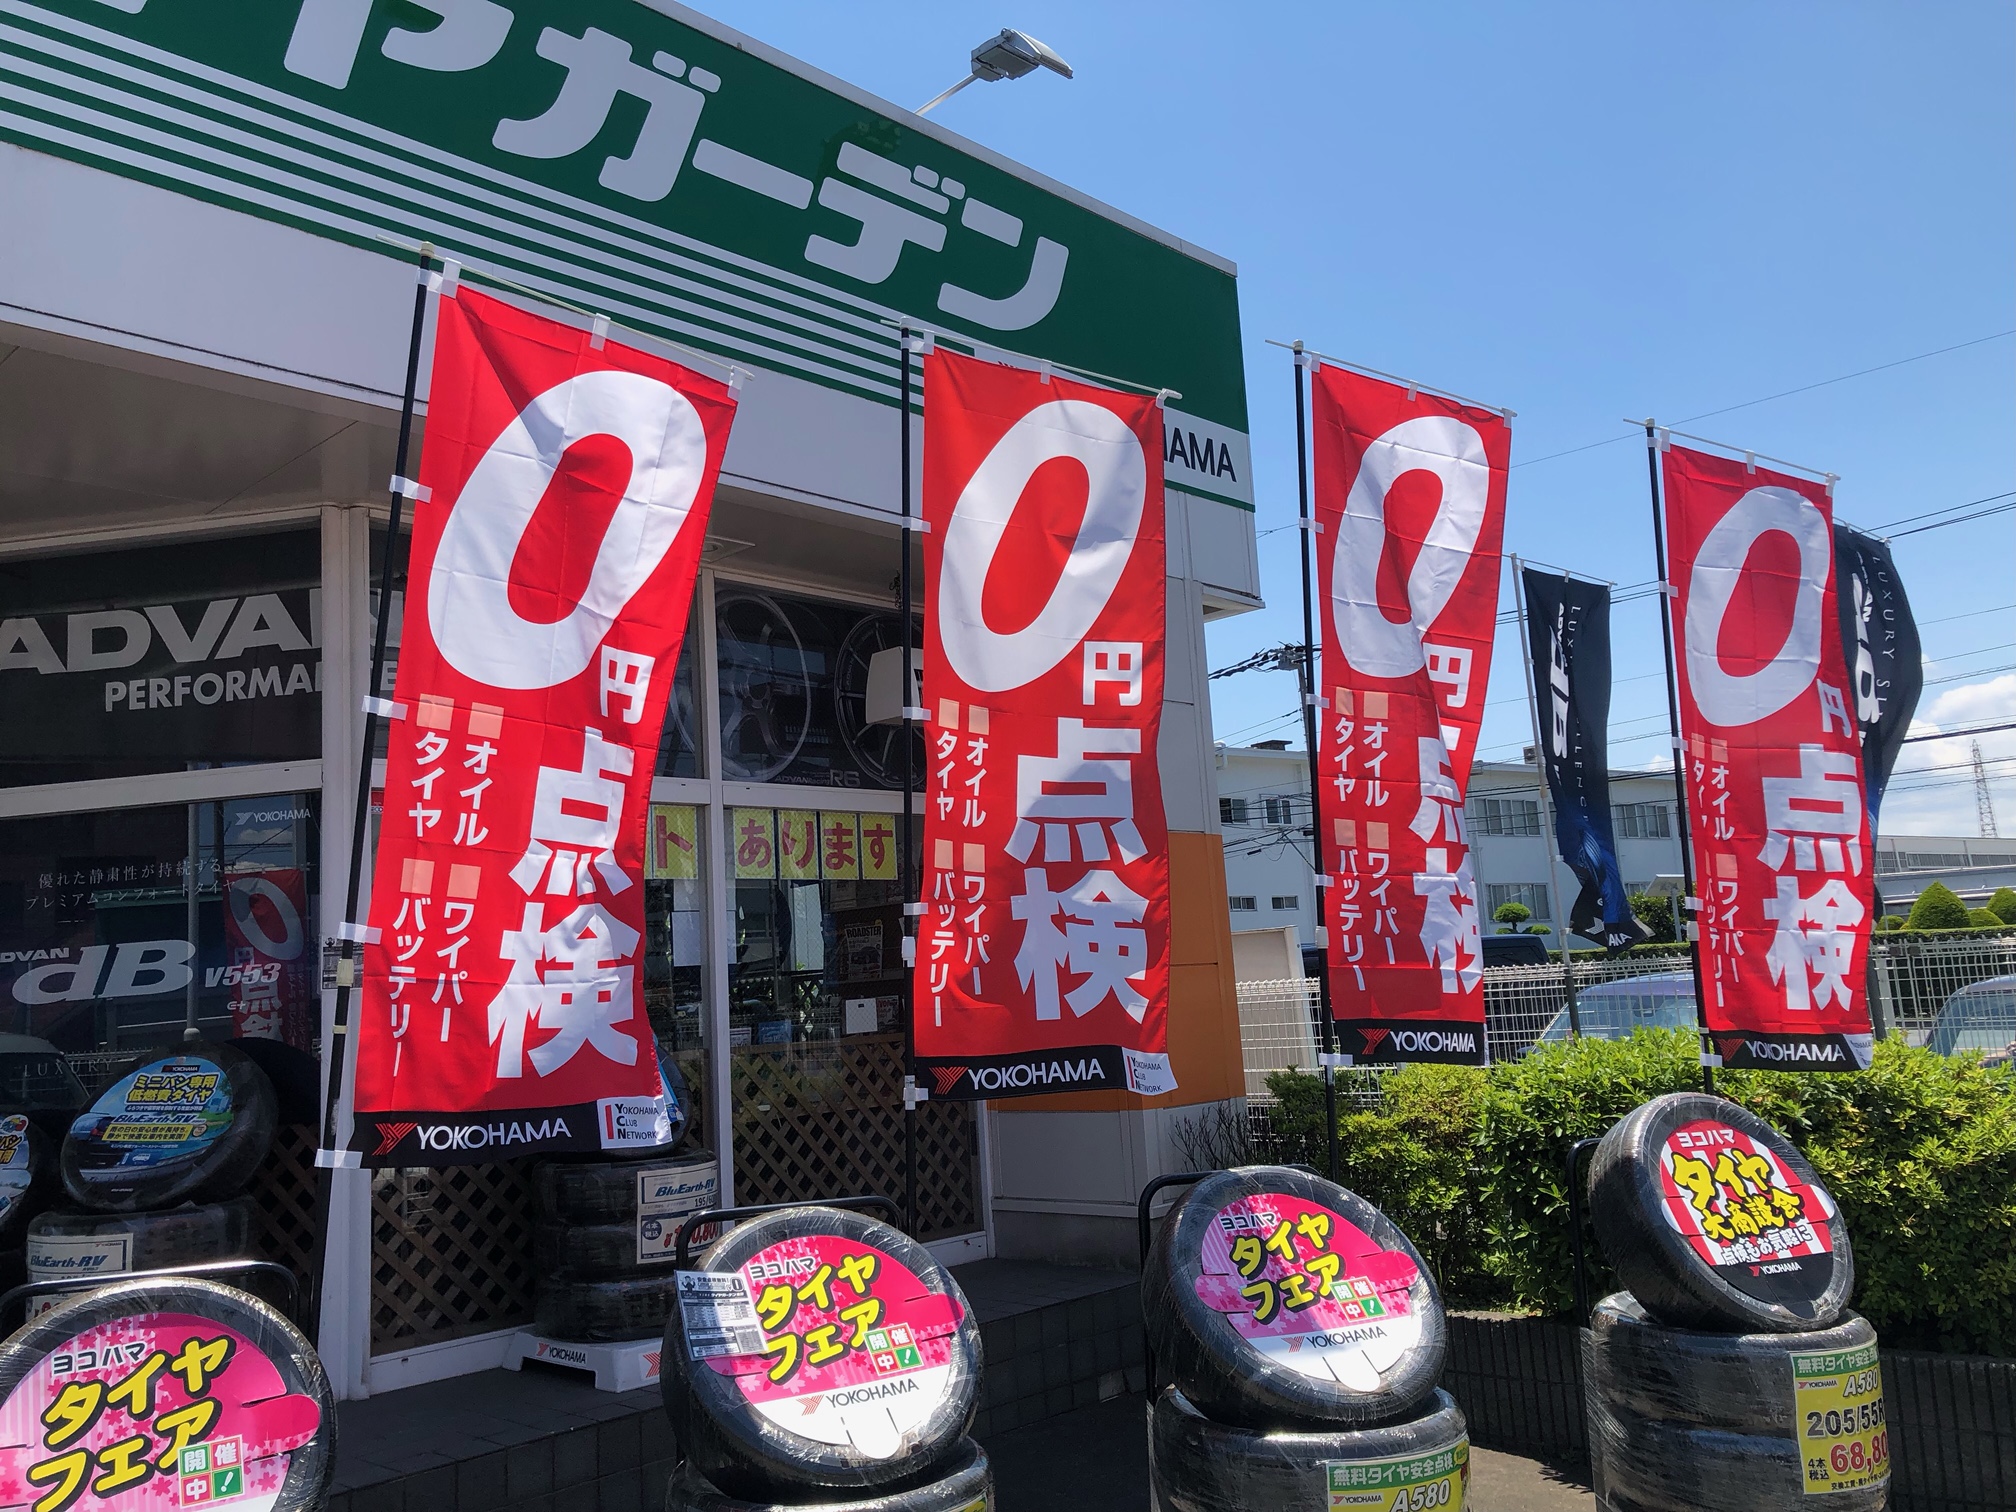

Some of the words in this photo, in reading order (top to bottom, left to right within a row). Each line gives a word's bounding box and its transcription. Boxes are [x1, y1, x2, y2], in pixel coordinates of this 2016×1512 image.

[936, 730, 959, 821] タイヤ
[1333, 717, 1356, 802] タイヤ
[1363, 721, 1390, 808] オイル
[408, 731, 450, 838] タイヤ
[453, 741, 500, 848] オイル
[963, 737, 990, 829] オイル
[1711, 764, 1736, 841] オイル
[252, 809, 312, 831] YOKOHAMA
[38, 857, 222, 890] 優れた静粛性が持続する
[25, 878, 236, 911] プレミアムコンフォートタイヤ
[1367, 851, 1400, 965] ワイパー
[963, 875, 991, 996] ワイパー
[1338, 848, 1366, 991] バッテリー
[1717, 880, 1745, 983] ワイパー
[0, 947, 69, 963] DVAN
[930, 872, 955, 1028] バッテリー
[12, 939, 196, 1005] dB
[205, 962, 282, 988] V553
[388, 897, 432, 1077] バッテリー
[431, 902, 475, 1043] ワイパー
[1390, 1031, 1477, 1053] YOKOHAMA
[1744, 1039, 1847, 1063] YOKOHAMA
[23, 1058, 113, 1078] LUXURY
[133, 1074, 218, 1089] ミニバン専用
[968, 1057, 1105, 1092] YOKOHAMA
[126, 1088, 213, 1103] 低燃費タイヤ
[614, 1103, 660, 1115] YOKOHAMA
[416, 1117, 573, 1151] YOKOHAMA
[616, 1115, 638, 1128] CLUB
[617, 1128, 658, 1140] NETWORK
[1677, 1128, 1735, 1147] ヨコハマ
[655, 1177, 716, 1198] BluEarth-RV
[1672, 1150, 1774, 1211] タイヤ
[1220, 1211, 1279, 1232] ヨコハマ
[1700, 1187, 1803, 1243] 大商談会
[30, 1255, 109, 1268] BluEarth-RV
[1231, 1211, 1336, 1279] タイヤ
[1720, 1224, 1814, 1266] 点検もお気軽に
[749, 1254, 817, 1282] ヨコハマ
[1760, 1262, 1803, 1275] YOKOHAMA
[756, 1254, 880, 1331] タイヤ
[1240, 1251, 1345, 1325] フェア
[767, 1299, 883, 1384] フェア
[1305, 1325, 1387, 1350] YOKOHAMA
[52, 1341, 147, 1376] ヨコハマ
[548, 1346, 586, 1364] YOKOHAMA
[43, 1335, 237, 1450] タイヤ
[826, 1378, 919, 1408] YOKOHAMA
[1808, 1379, 1838, 1389] YOKOHAMA
[1843, 1367, 1879, 1398] A580
[28, 1401, 224, 1512] フェア
[1333, 1452, 1454, 1487] 無料タイヤ安全点検
[1807, 1457, 1828, 1469] 4本
[1808, 1468, 1830, 1481] 税込
[1345, 1495, 1383, 1505] YOKOHAMA
[1390, 1478, 1451, 1512] A580
